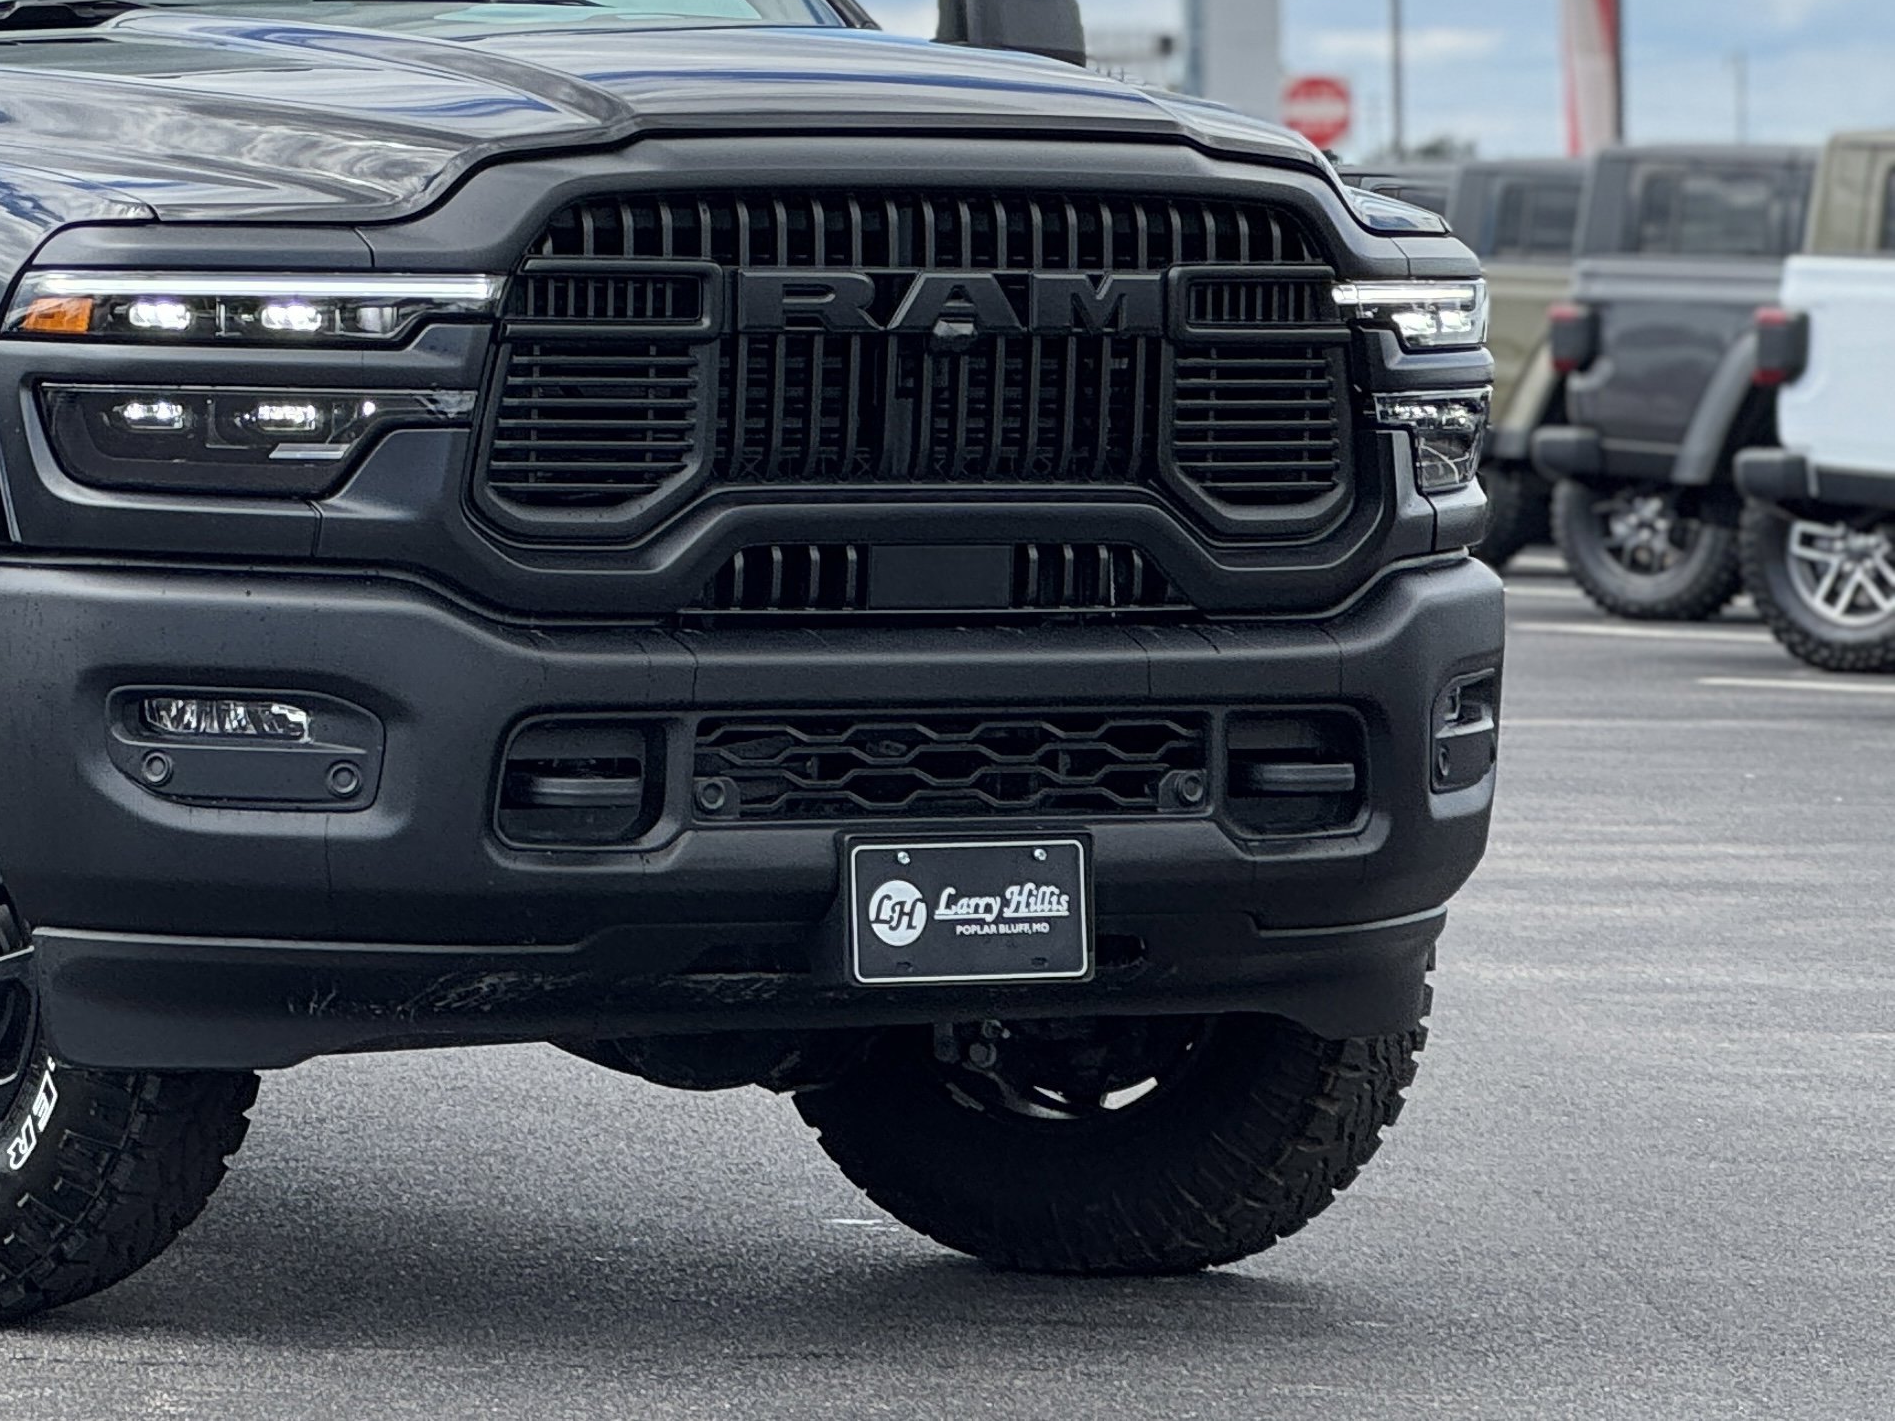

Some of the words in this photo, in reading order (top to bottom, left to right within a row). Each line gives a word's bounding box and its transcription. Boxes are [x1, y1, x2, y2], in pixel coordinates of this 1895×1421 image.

[738, 269, 1162, 334] RAM
[934, 886, 1001, 922] Larry
[1003, 882, 1070, 918] Hillis
[956, 924, 997, 935] POPLAR
[999, 923, 1031, 935] BLUFF,
[1032, 922, 1050, 933] MO
